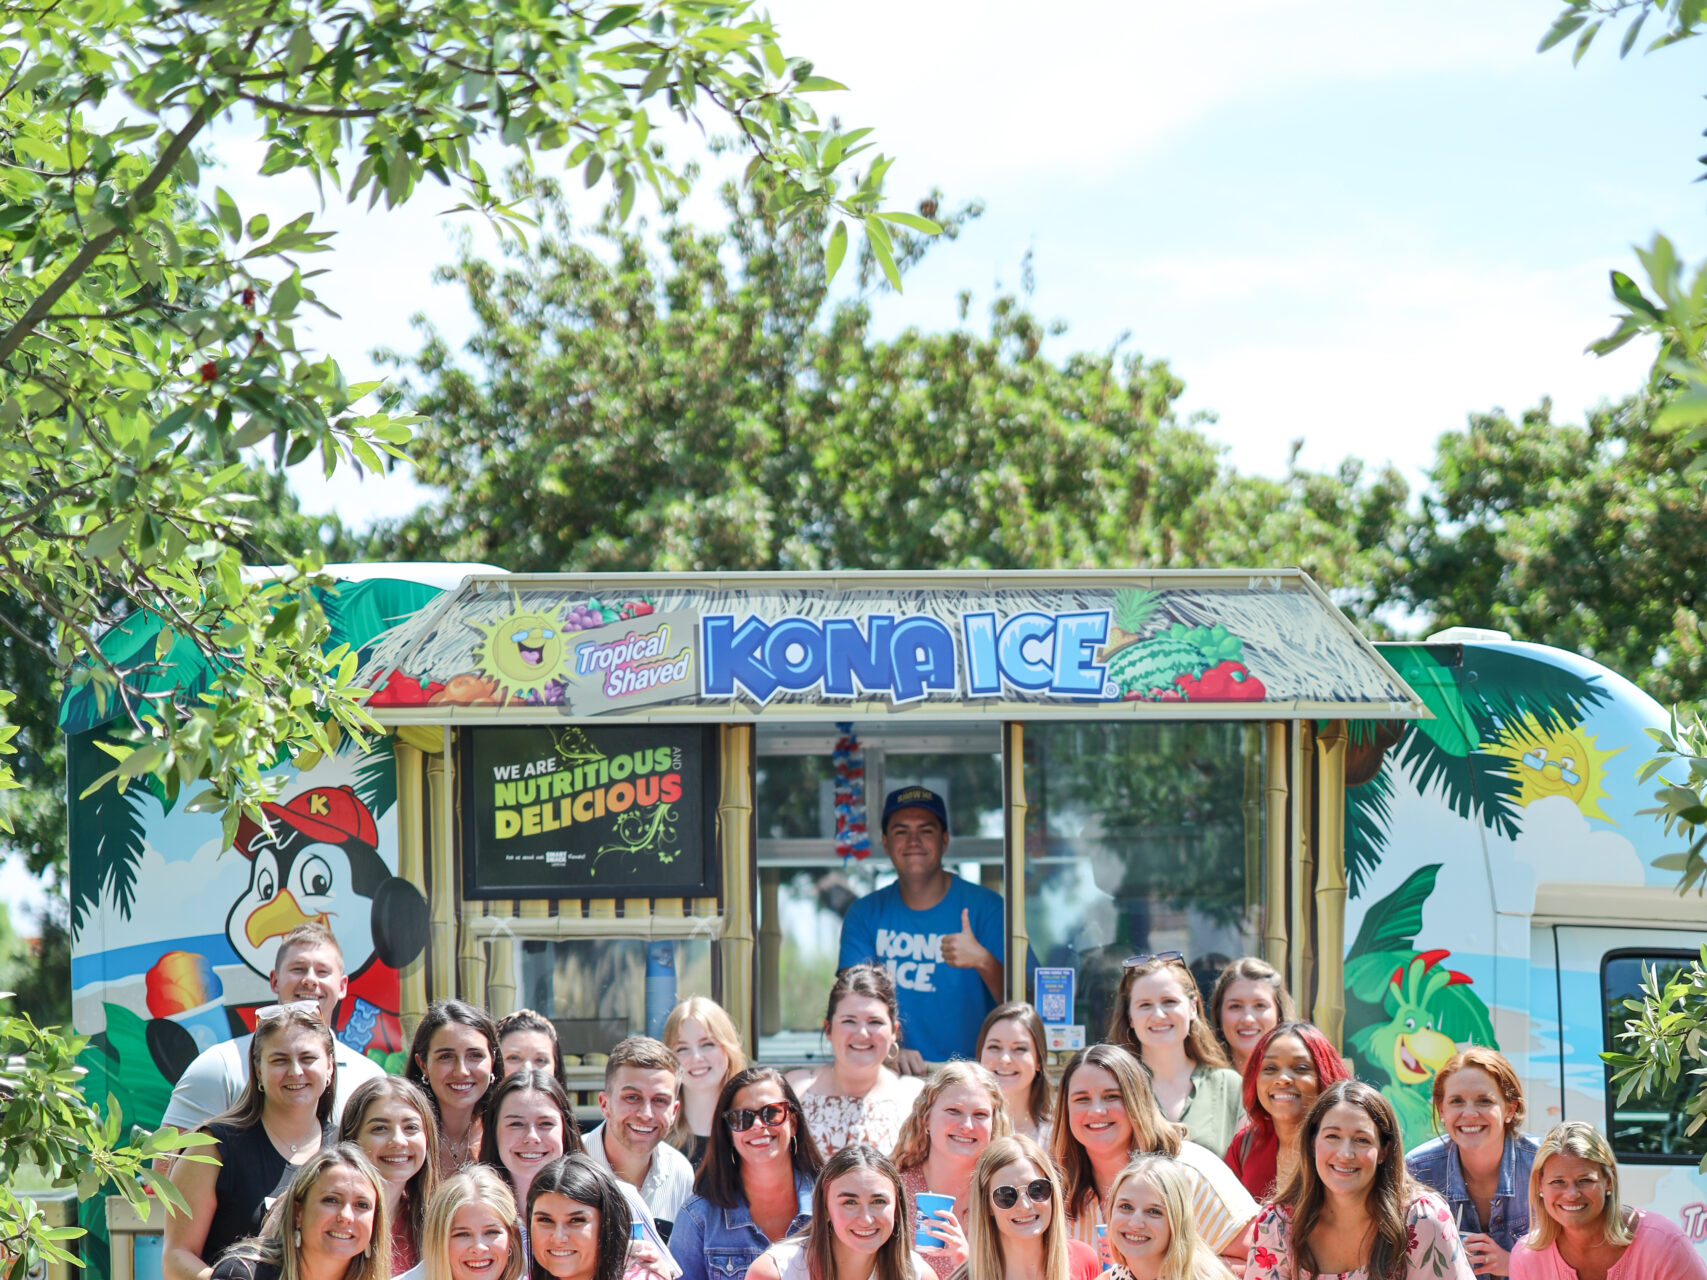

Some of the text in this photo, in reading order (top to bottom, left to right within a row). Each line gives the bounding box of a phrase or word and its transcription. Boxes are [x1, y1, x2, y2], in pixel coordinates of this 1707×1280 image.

[578, 626, 669, 674] Tropical
[702, 609, 1110, 704] KONA ICE
[605, 651, 691, 697] Shaved
[493, 757, 556, 781] WE ARE
[494, 746, 672, 807] NUTRITIOUS
[672, 746, 682, 770] AND
[310, 793, 329, 817] K
[494, 772, 682, 840] DELICIOUS
